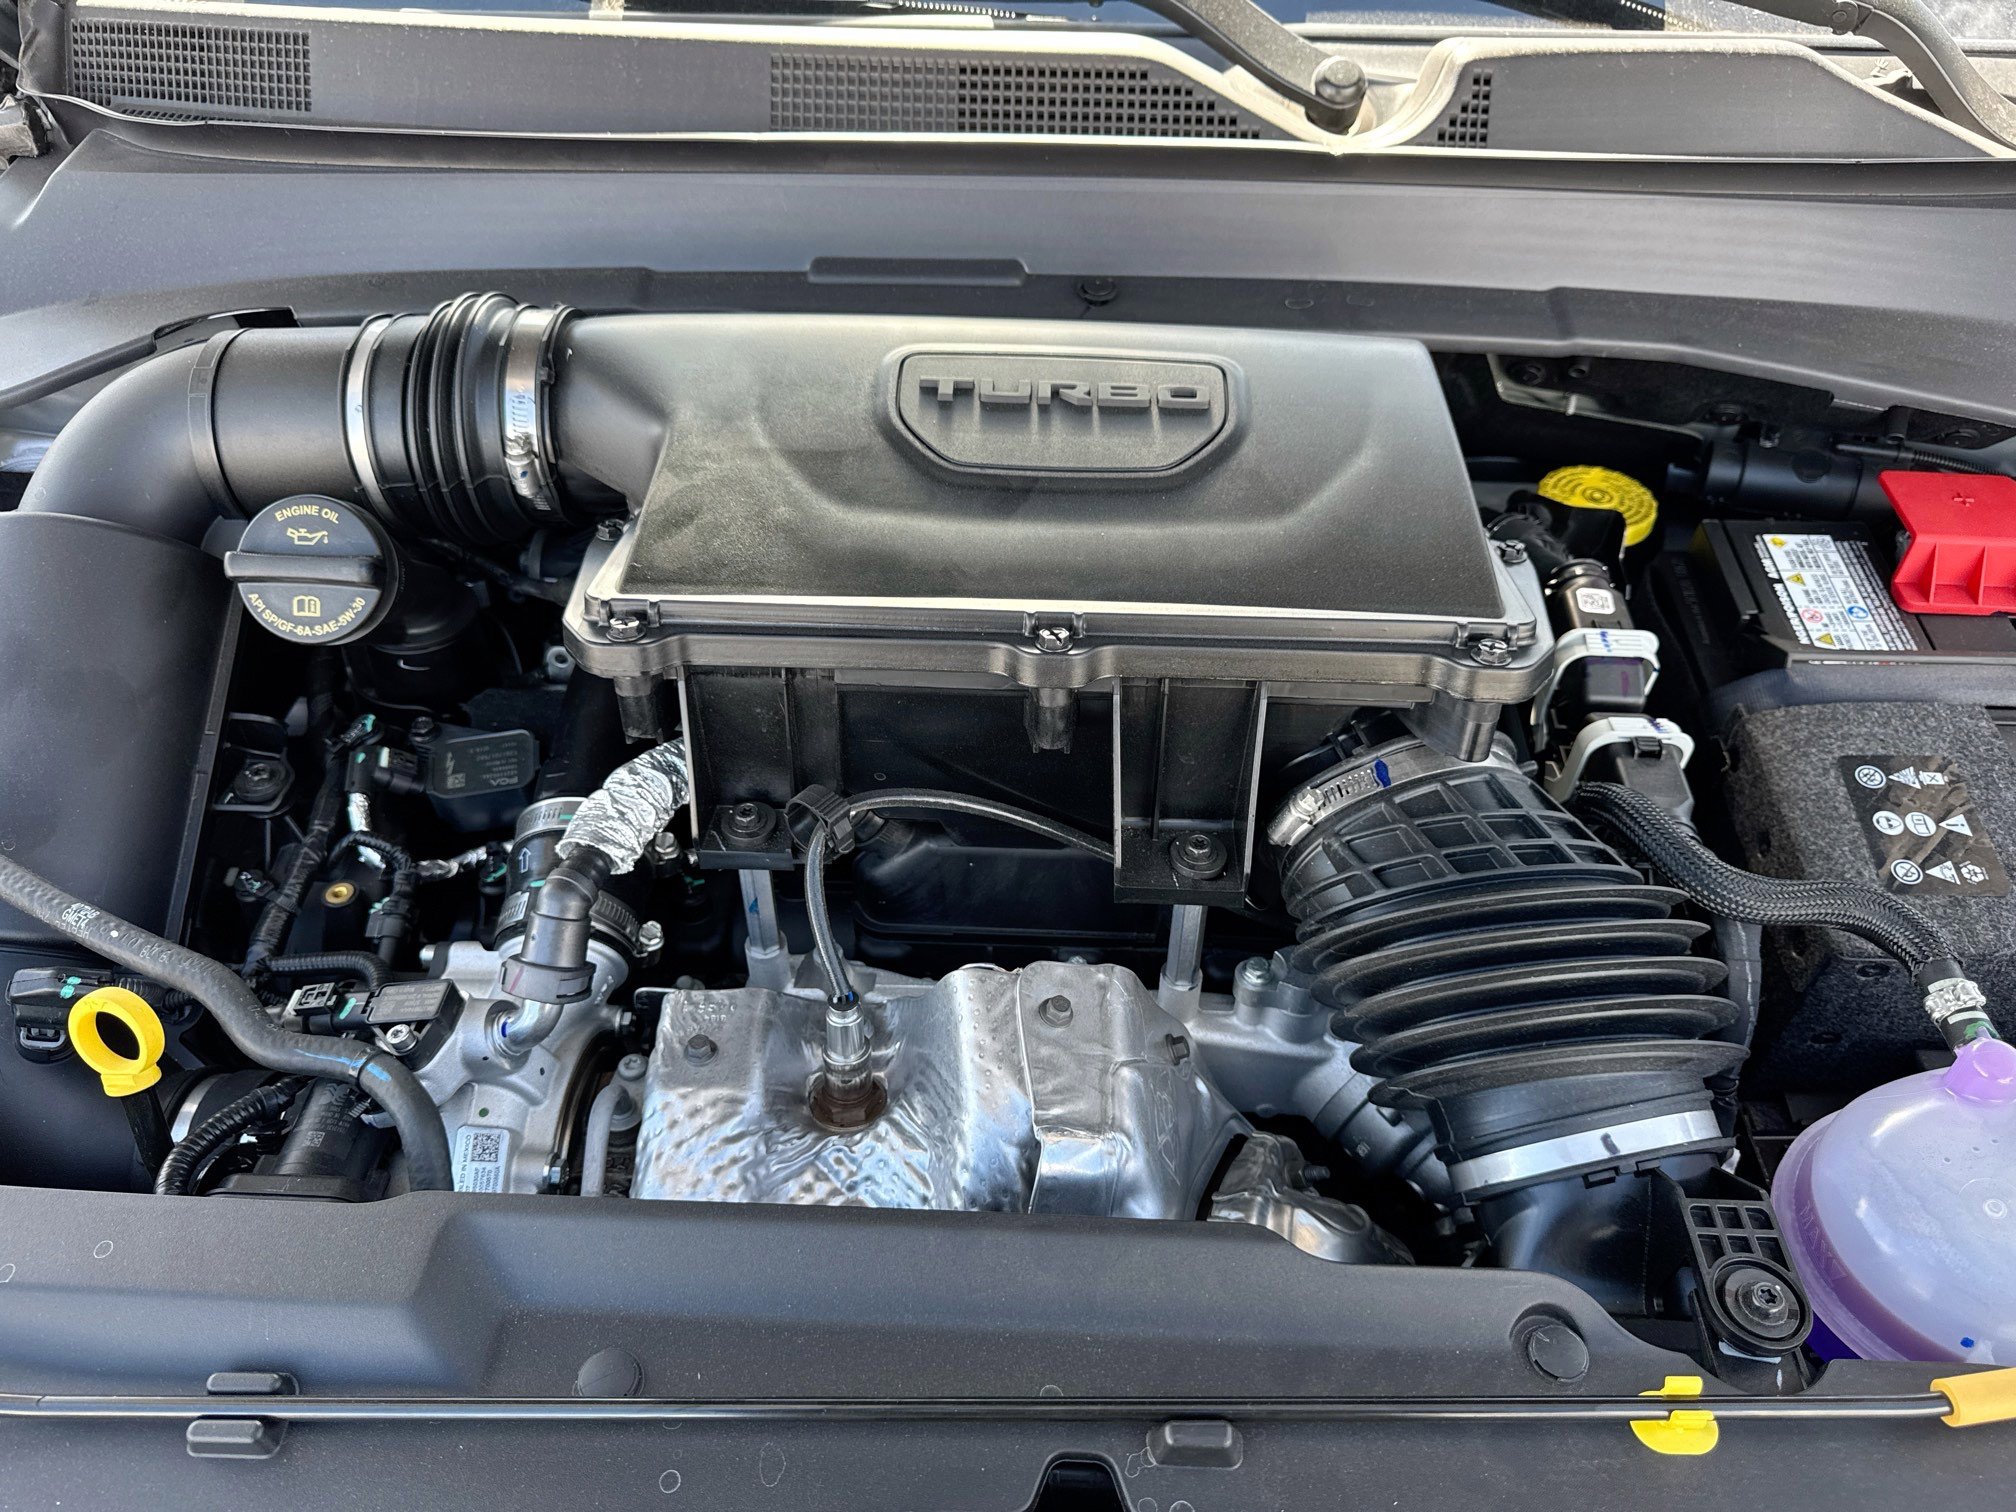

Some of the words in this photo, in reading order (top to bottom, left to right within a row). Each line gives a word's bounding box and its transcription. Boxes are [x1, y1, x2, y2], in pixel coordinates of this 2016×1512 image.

[919, 376, 1211, 410] TURBO
[274, 505, 319, 522] ENGINE
[321, 507, 340, 524] OIL
[248, 592, 265, 613] API
